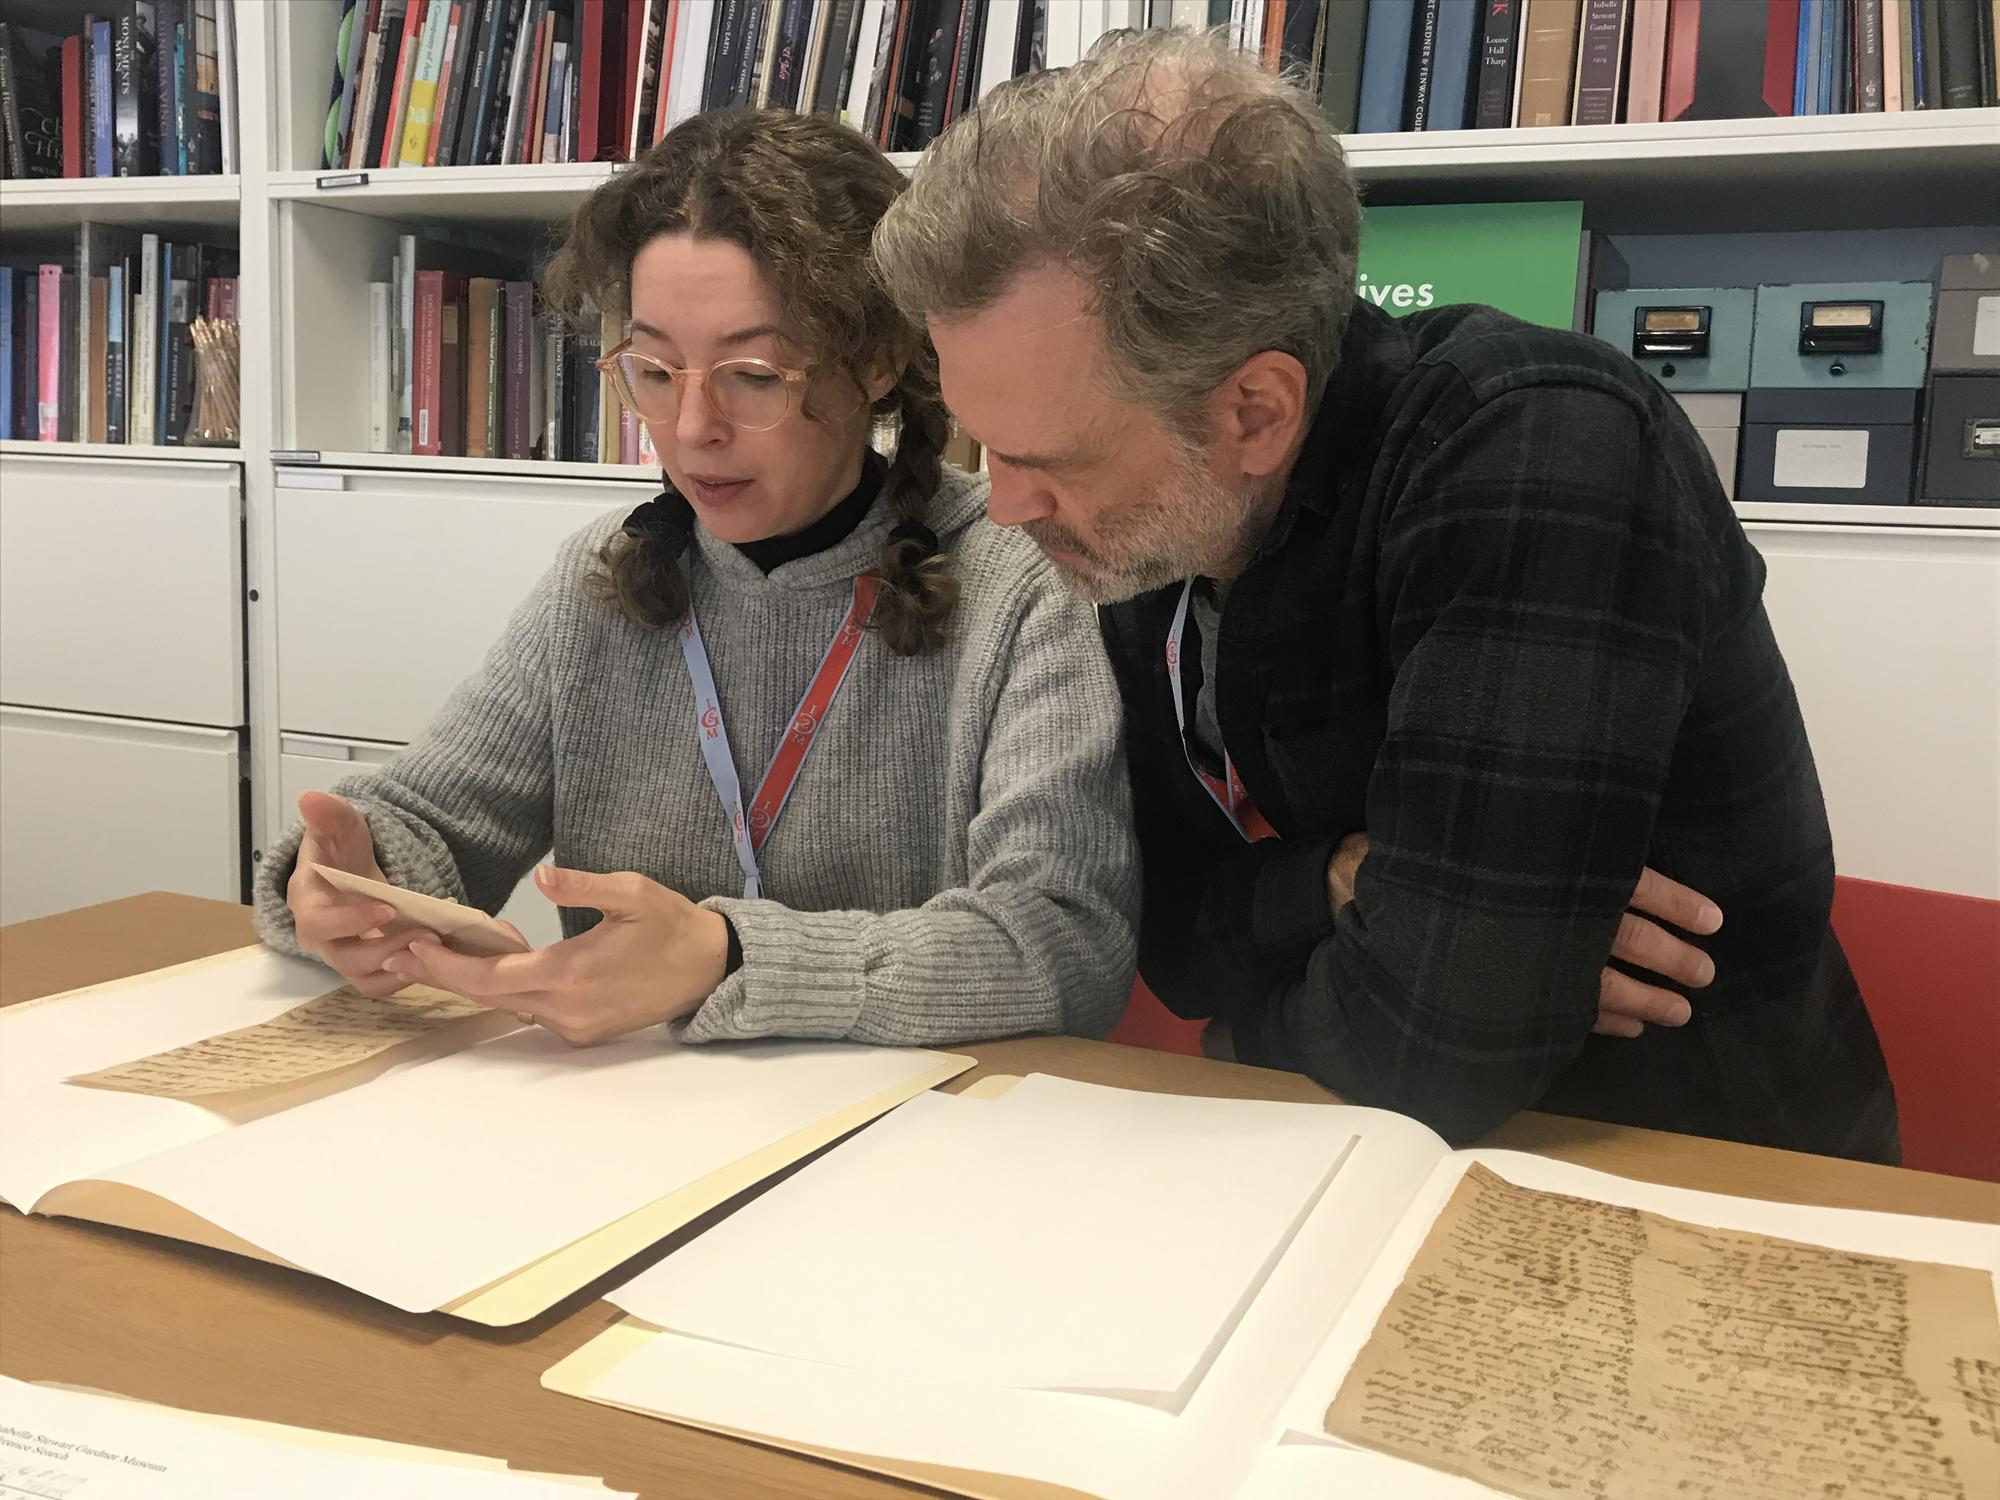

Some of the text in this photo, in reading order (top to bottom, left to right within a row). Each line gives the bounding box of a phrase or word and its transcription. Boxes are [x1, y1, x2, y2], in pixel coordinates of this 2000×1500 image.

[725, 0, 737, 20] AVEN
[749, 7, 757, 27] CARLO
[967, 0, 975, 18] ATE
[1492, 0, 1508, 16] K
[1591, 11, 1616, 20] Stewart
[426, 5, 441, 49] Company
[1588, 22, 1617, 32] Gardner
[1866, 14, 1875, 55] MUSEUM
[721, 30, 731, 56] EARTH
[743, 28, 754, 58] CRIVELLI
[1485, 35, 1509, 45] Louise
[1488, 46, 1505, 55] Hall
[114, 40, 122, 73] MEN
[120, 16, 130, 95] MONUMENTS
[423, 50, 433, 62] of
[957, 23, 971, 88] LANDSCAPES
[1413, 0, 1436, 132] RT GARDNER & FENWAY COUR
[1484, 56, 1507, 67] Tharp
[159, 66, 168, 88] DA
[737, 67, 747, 94] VENICE
[159, 91, 169, 137] VINCI
[1359, 273, 1434, 307] ives
[0, 1424, 168, 1472] abella Stewart Gardner Museum
[32, 1446, 70, 1461] Search
